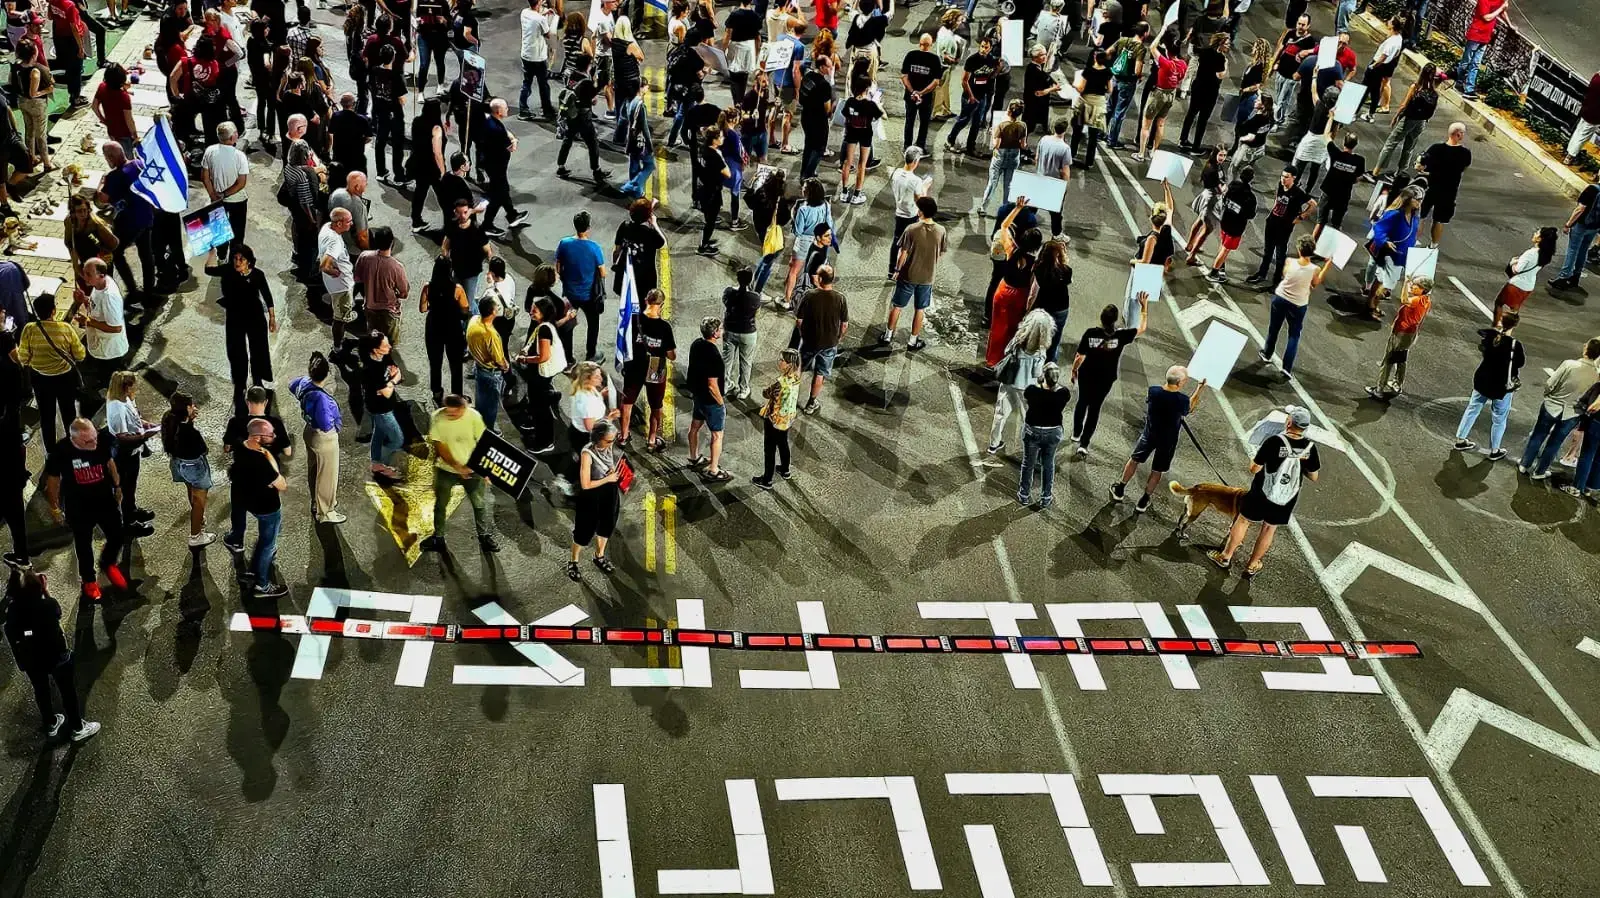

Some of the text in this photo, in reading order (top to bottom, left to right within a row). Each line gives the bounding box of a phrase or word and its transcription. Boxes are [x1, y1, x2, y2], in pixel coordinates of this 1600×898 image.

[479, 456, 518, 487] עכשיו!
[486, 446, 522, 475] עסקה
[290, 587, 1383, 694] ביחד ננצח
[593, 773, 1491, 898] הופקרנו
